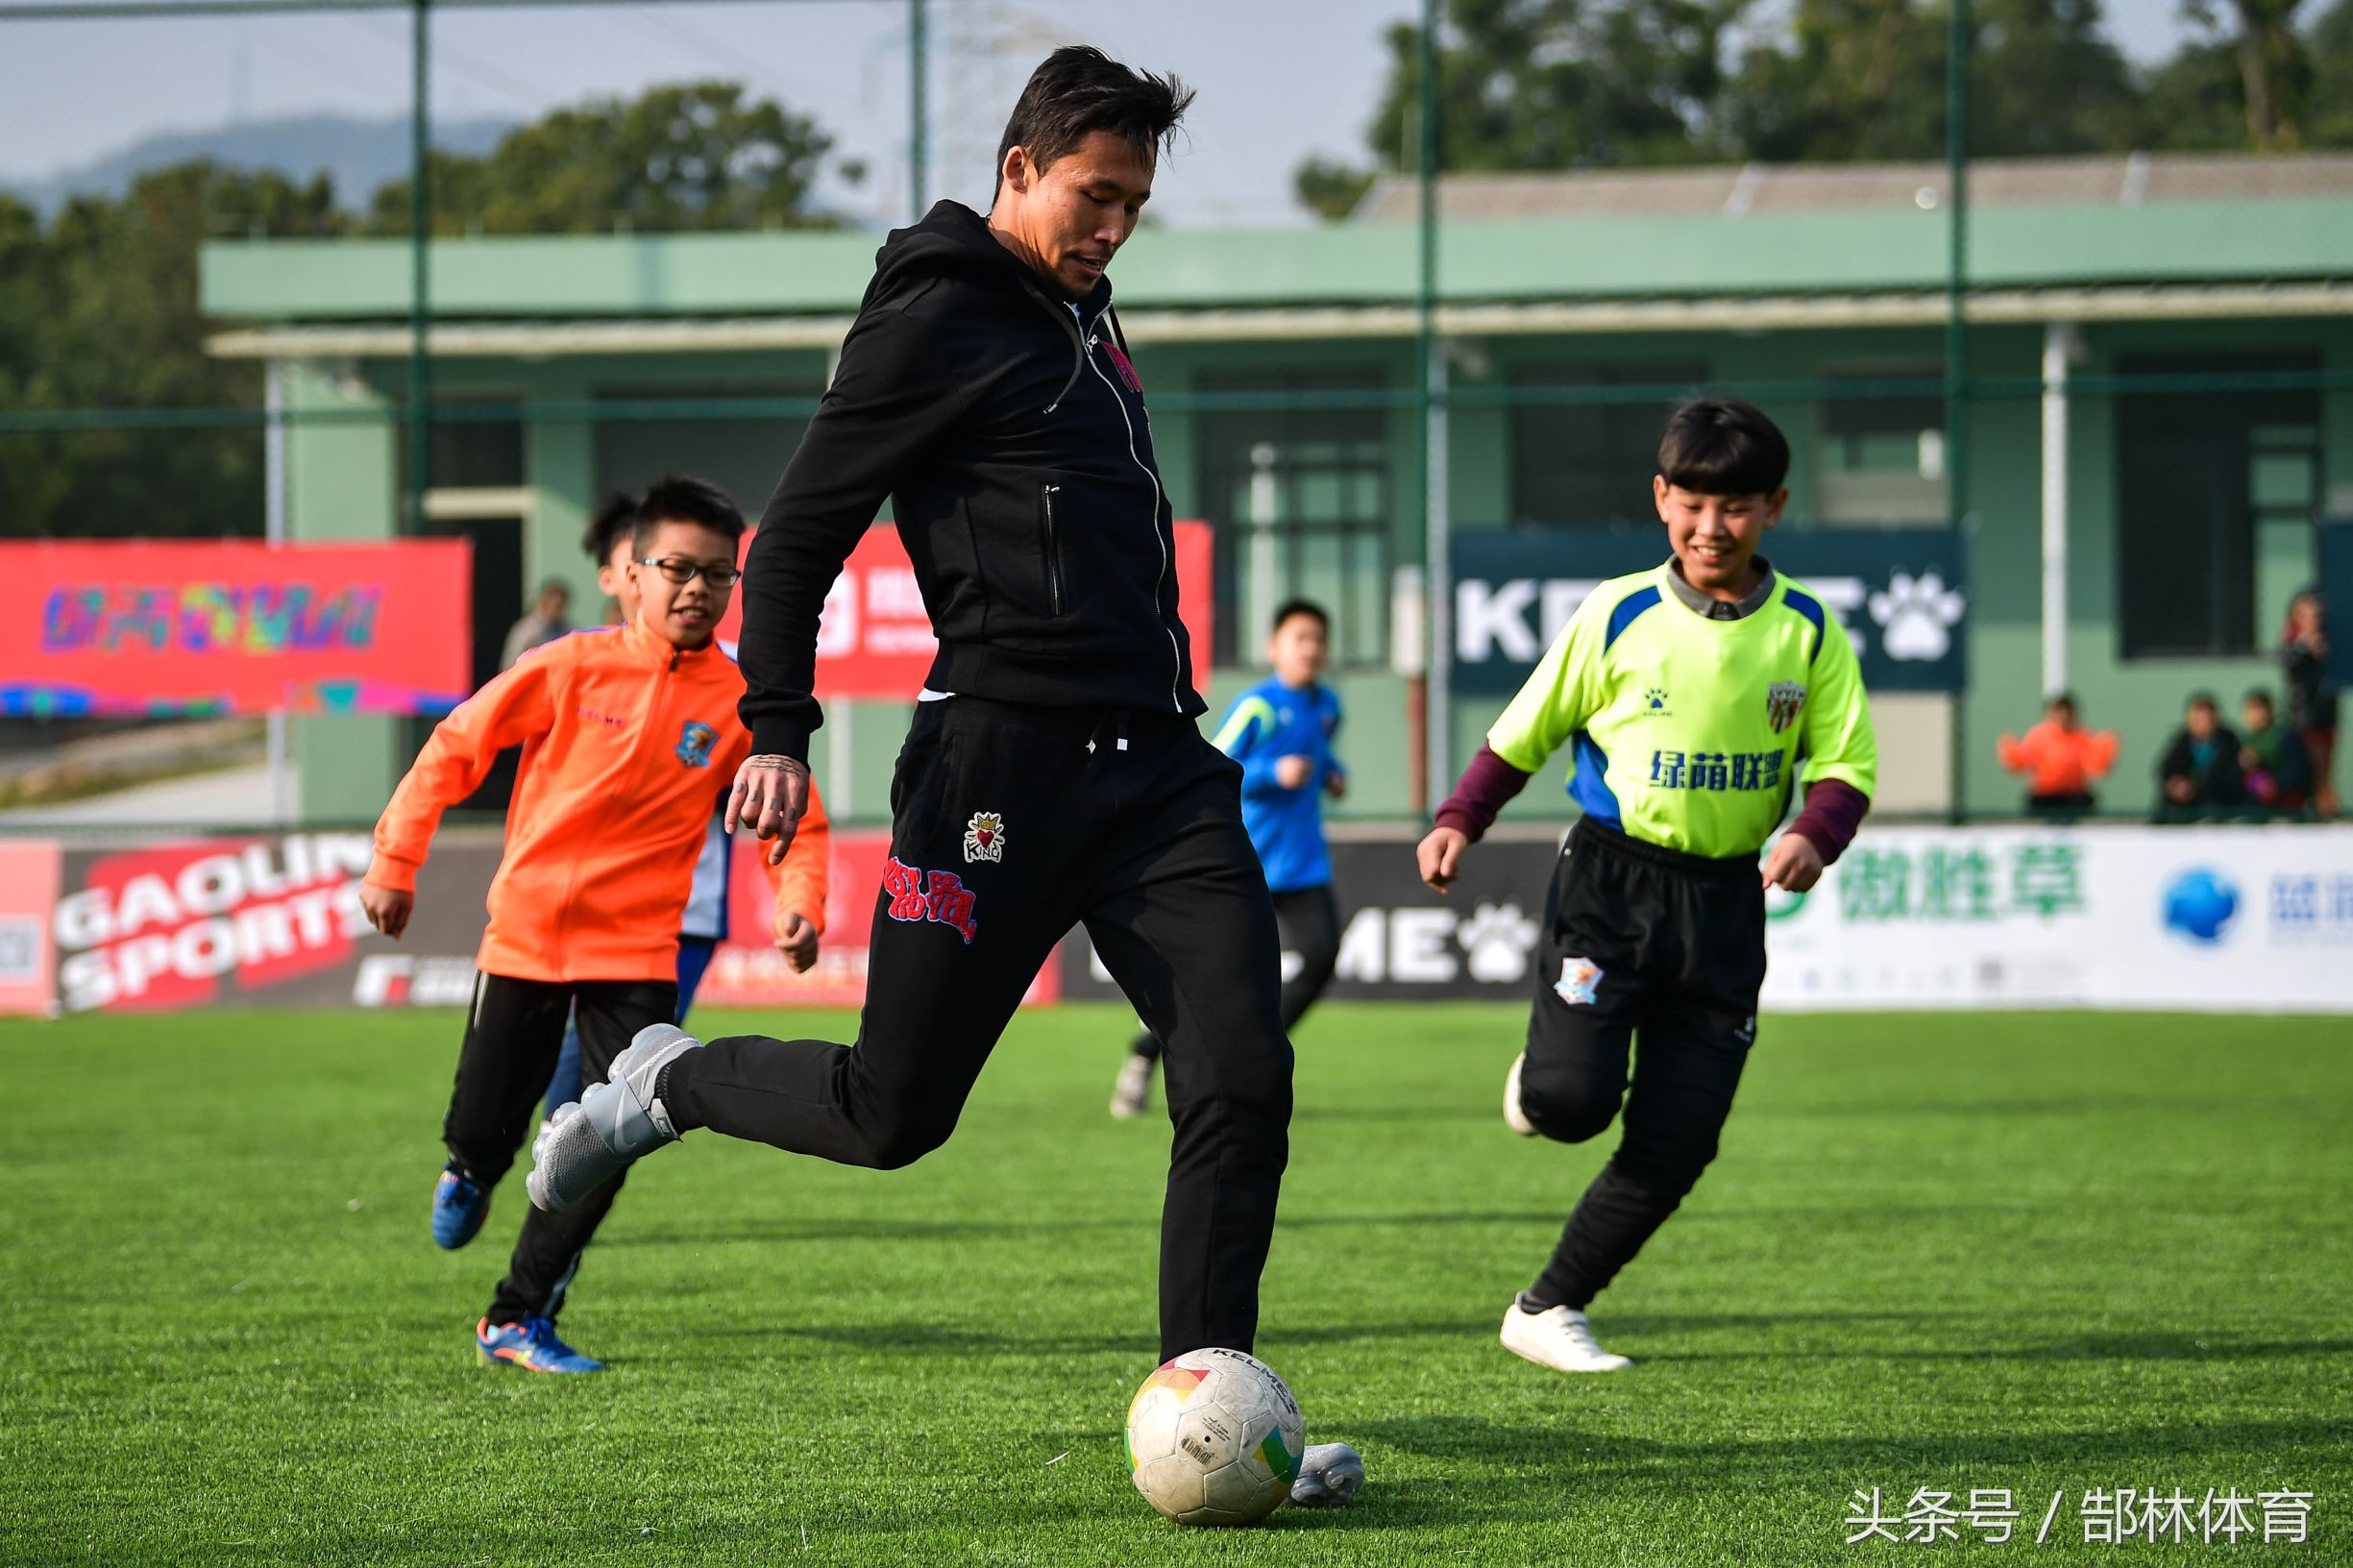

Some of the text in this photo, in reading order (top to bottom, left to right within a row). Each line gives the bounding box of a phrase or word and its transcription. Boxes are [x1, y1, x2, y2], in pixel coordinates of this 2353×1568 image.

[1650, 748, 1784, 790] 绿荫联盟
[1213, 1349, 1288, 1398] KELME
